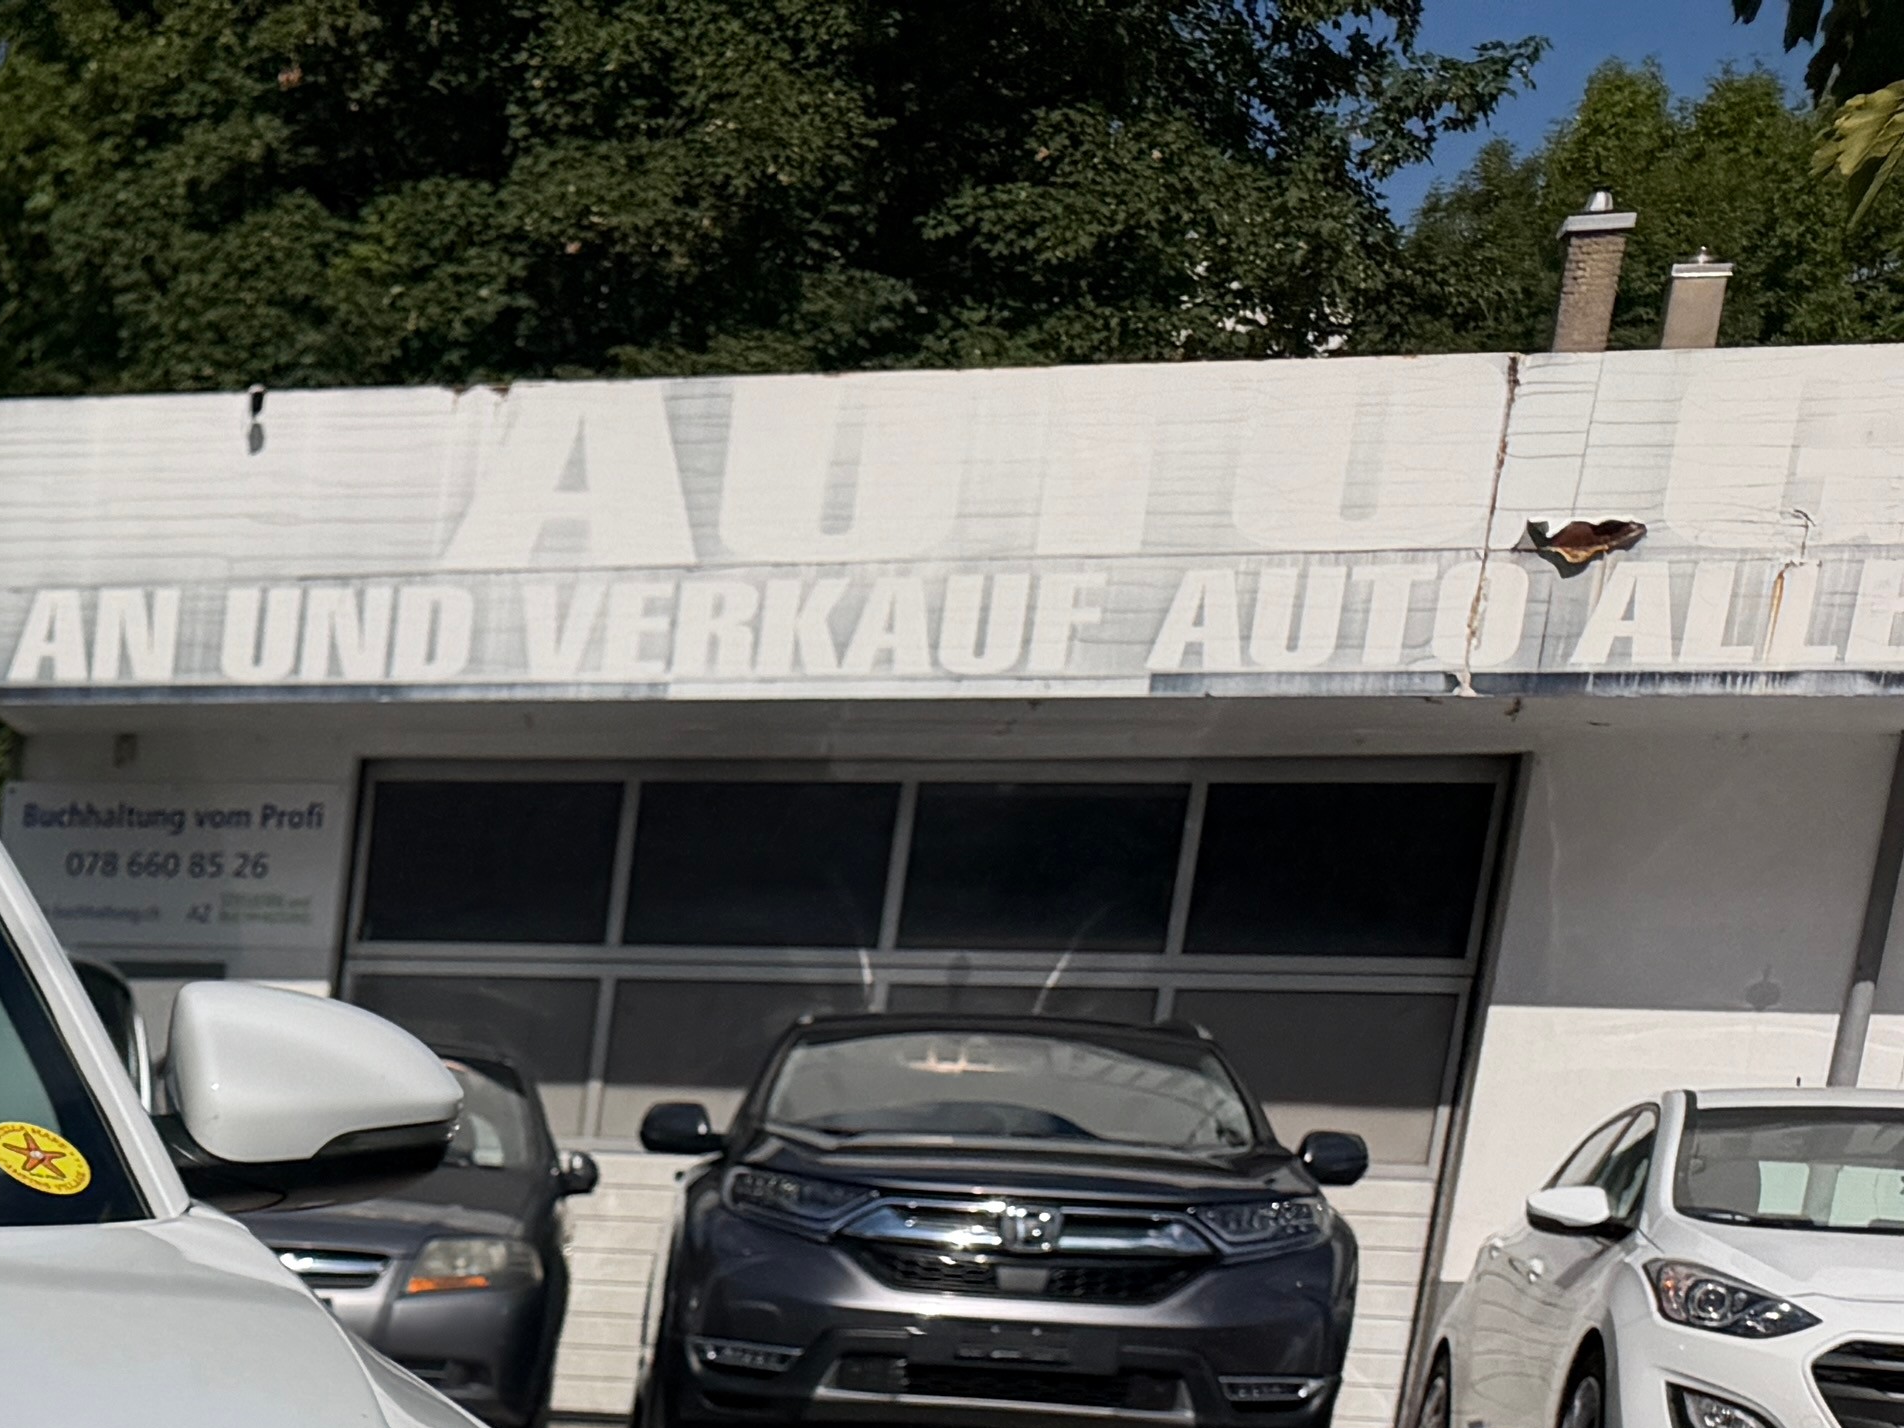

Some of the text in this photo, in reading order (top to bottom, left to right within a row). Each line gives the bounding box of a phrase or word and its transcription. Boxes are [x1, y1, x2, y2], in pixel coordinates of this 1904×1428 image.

[6, 586, 182, 682] AN
[220, 584, 476, 682] UND
[522, 568, 1110, 681] VERKAUF
[1144, 558, 1530, 673] AUTO
[22, 802, 325, 835] Buchhaltung vom Profi
[64, 850, 120, 879] 078
[126, 850, 182, 879] 660
[232, 850, 271, 879] 26
